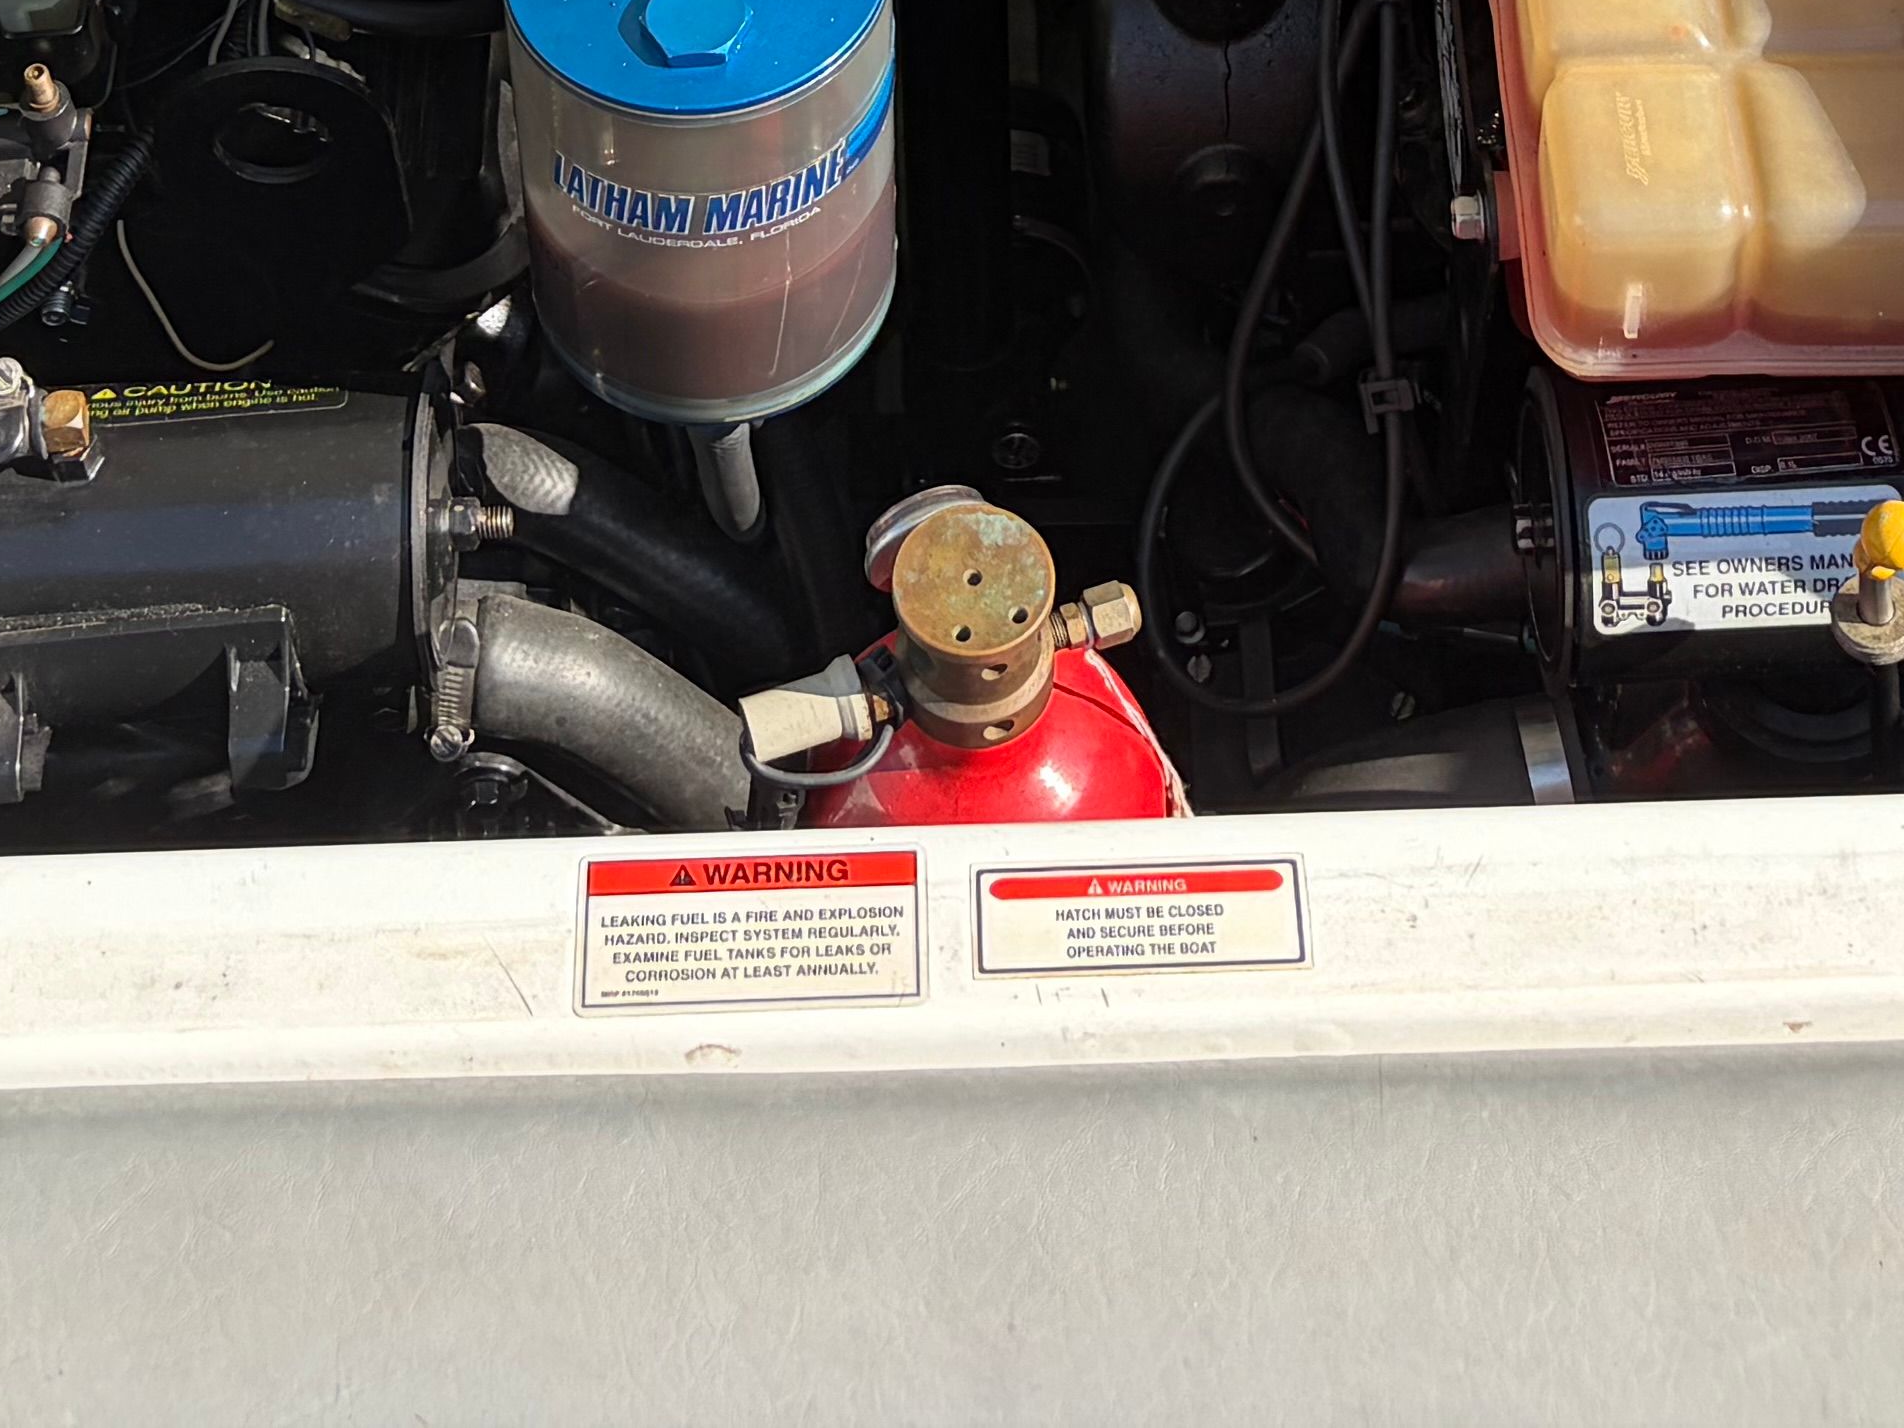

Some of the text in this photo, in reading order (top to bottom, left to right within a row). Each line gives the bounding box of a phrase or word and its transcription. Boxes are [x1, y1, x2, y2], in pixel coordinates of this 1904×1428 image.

[552, 136, 847, 236] LATHAM MARINE
[572, 204, 822, 249] FORT LAUDERDALE, FLORIDA
[123, 379, 272, 398] CAUTION
[180, 400, 220, 412] when
[223, 395, 273, 409] engine
[275, 393, 288, 404] is
[1671, 552, 1855, 577] SEE OWNERS MAN
[1693, 579, 1807, 599] FOR WATER
[703, 858, 849, 886] WARNING
[1107, 878, 1188, 894] WARNING
[600, 905, 904, 928] LEAKING FUEL IS A FIRE AND EXPLOSION
[1055, 903, 1225, 922] HATCH MUST BE CLOSED
[674, 930, 738, 945] INSPECT
[743, 927, 803, 942] SYSTEM
[807, 924, 900, 940] REGULARLY.
[1066, 922, 1215, 940] AND SECURE BEFORE
[612, 942, 892, 965] EXAMINE FUEL TANKS FOR LEAKS OR
[1066, 941, 1217, 959] OPERATING THE BOAT
[624, 961, 879, 983] CORROSION AT LEAST ANNUALLY.
